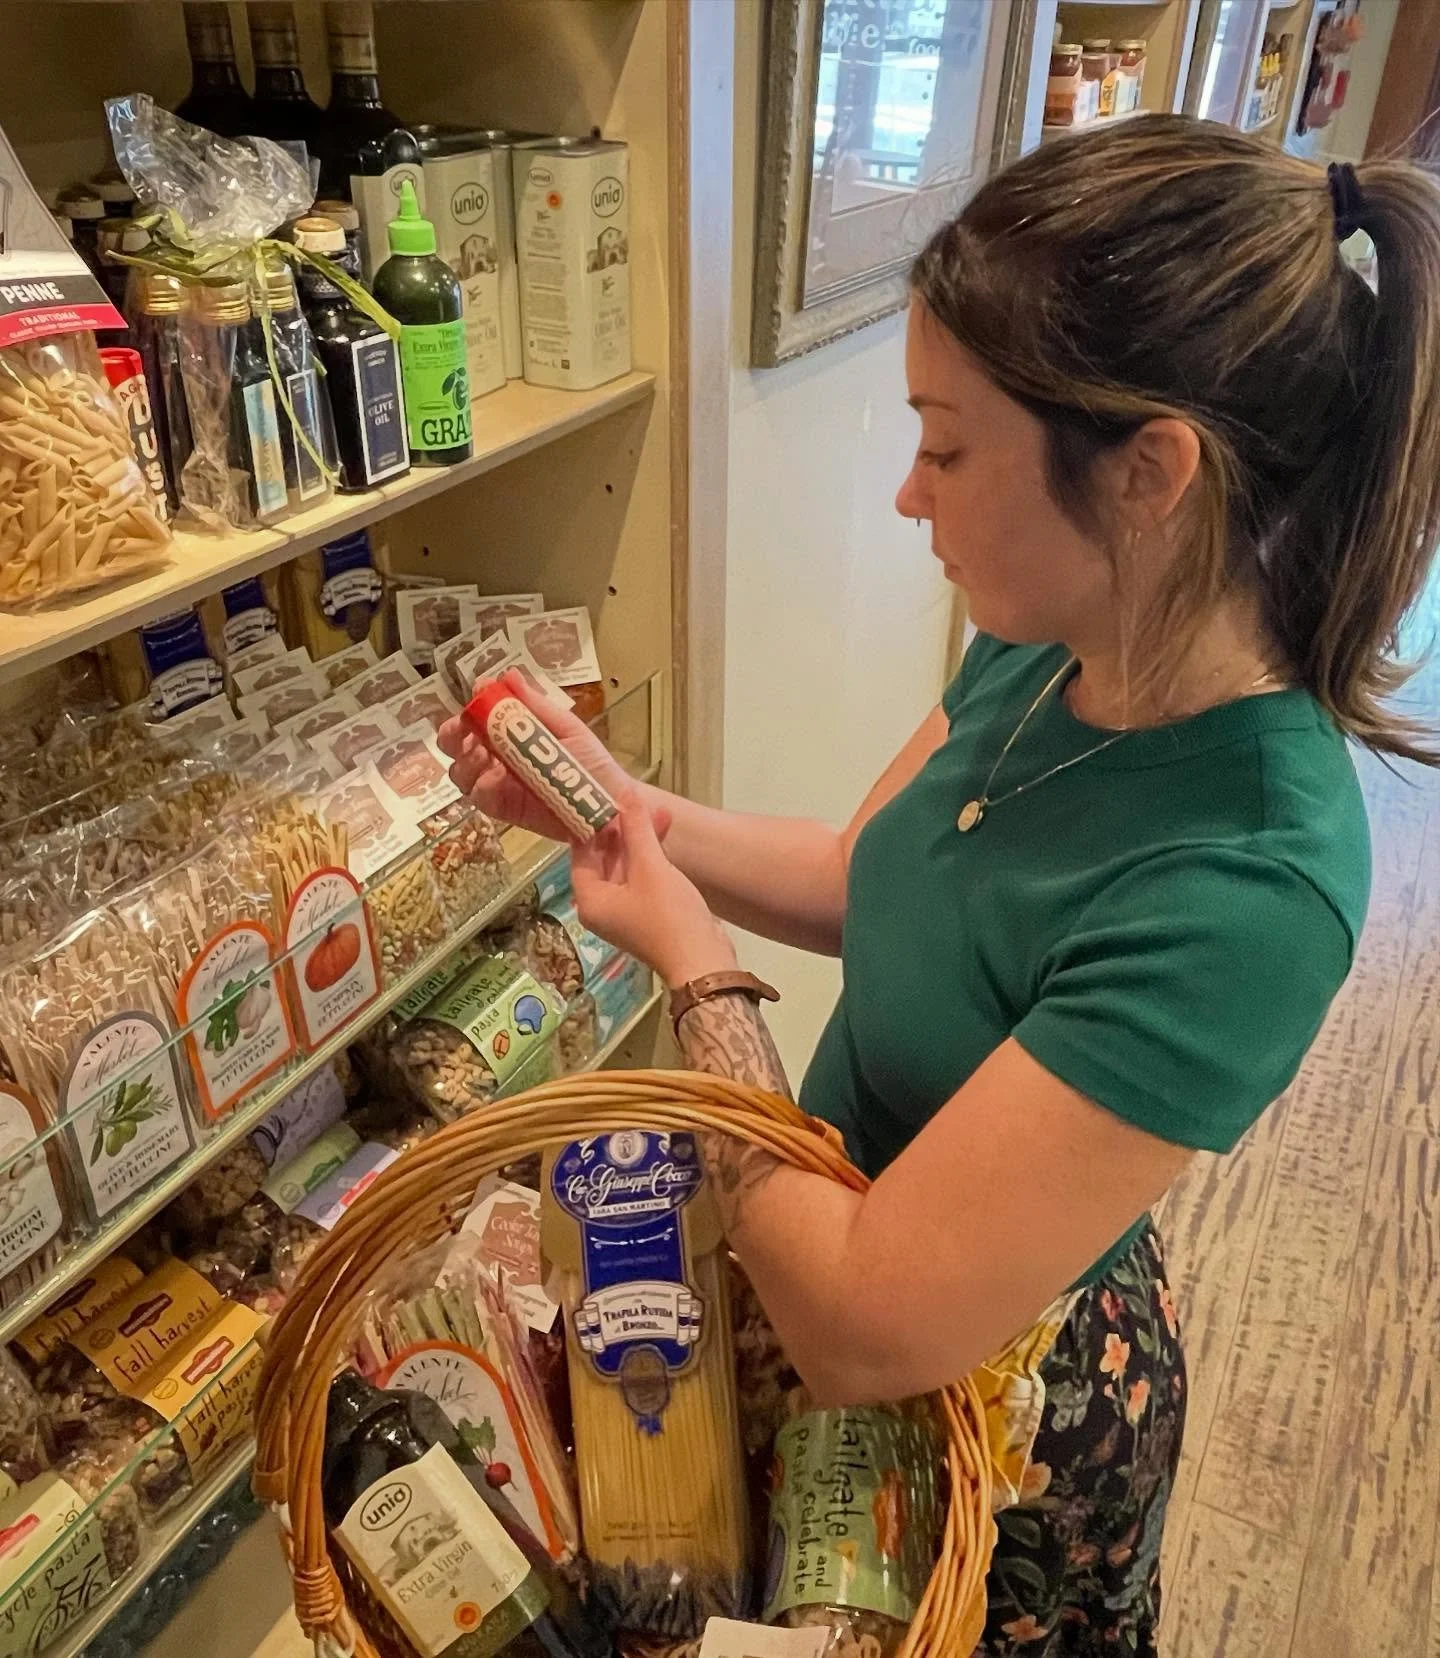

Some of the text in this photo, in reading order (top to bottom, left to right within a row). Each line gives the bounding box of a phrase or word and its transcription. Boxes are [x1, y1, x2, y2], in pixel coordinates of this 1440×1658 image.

[454, 194, 486, 211] unio
[594, 190, 622, 205] unio
[0, 281, 65, 305] PENNE
[18, 311, 81, 327] TRADITIONAL
[368, 400, 395, 417] OLIVE
[374, 414, 391, 426] OIL
[131, 396, 168, 524] DUST
[506, 714, 601, 812] DUST
[439, 977, 492, 1020] tailgate
[470, 1007, 500, 1042] pasta
[82, 1025, 141, 1068] VALENTE
[112, 1339, 154, 1384] fall
[149, 1296, 213, 1349] harvest
[185, 1391, 218, 1441] fall
[814, 1417, 873, 1537] tailgate
[366, 1487, 408, 1527] unio
[44, 1524, 91, 1588] pasta
[795, 1491, 822, 1595] celebrate
[396, 1539, 474, 1606] Extra Virgin
[814, 1554, 833, 1588] and
